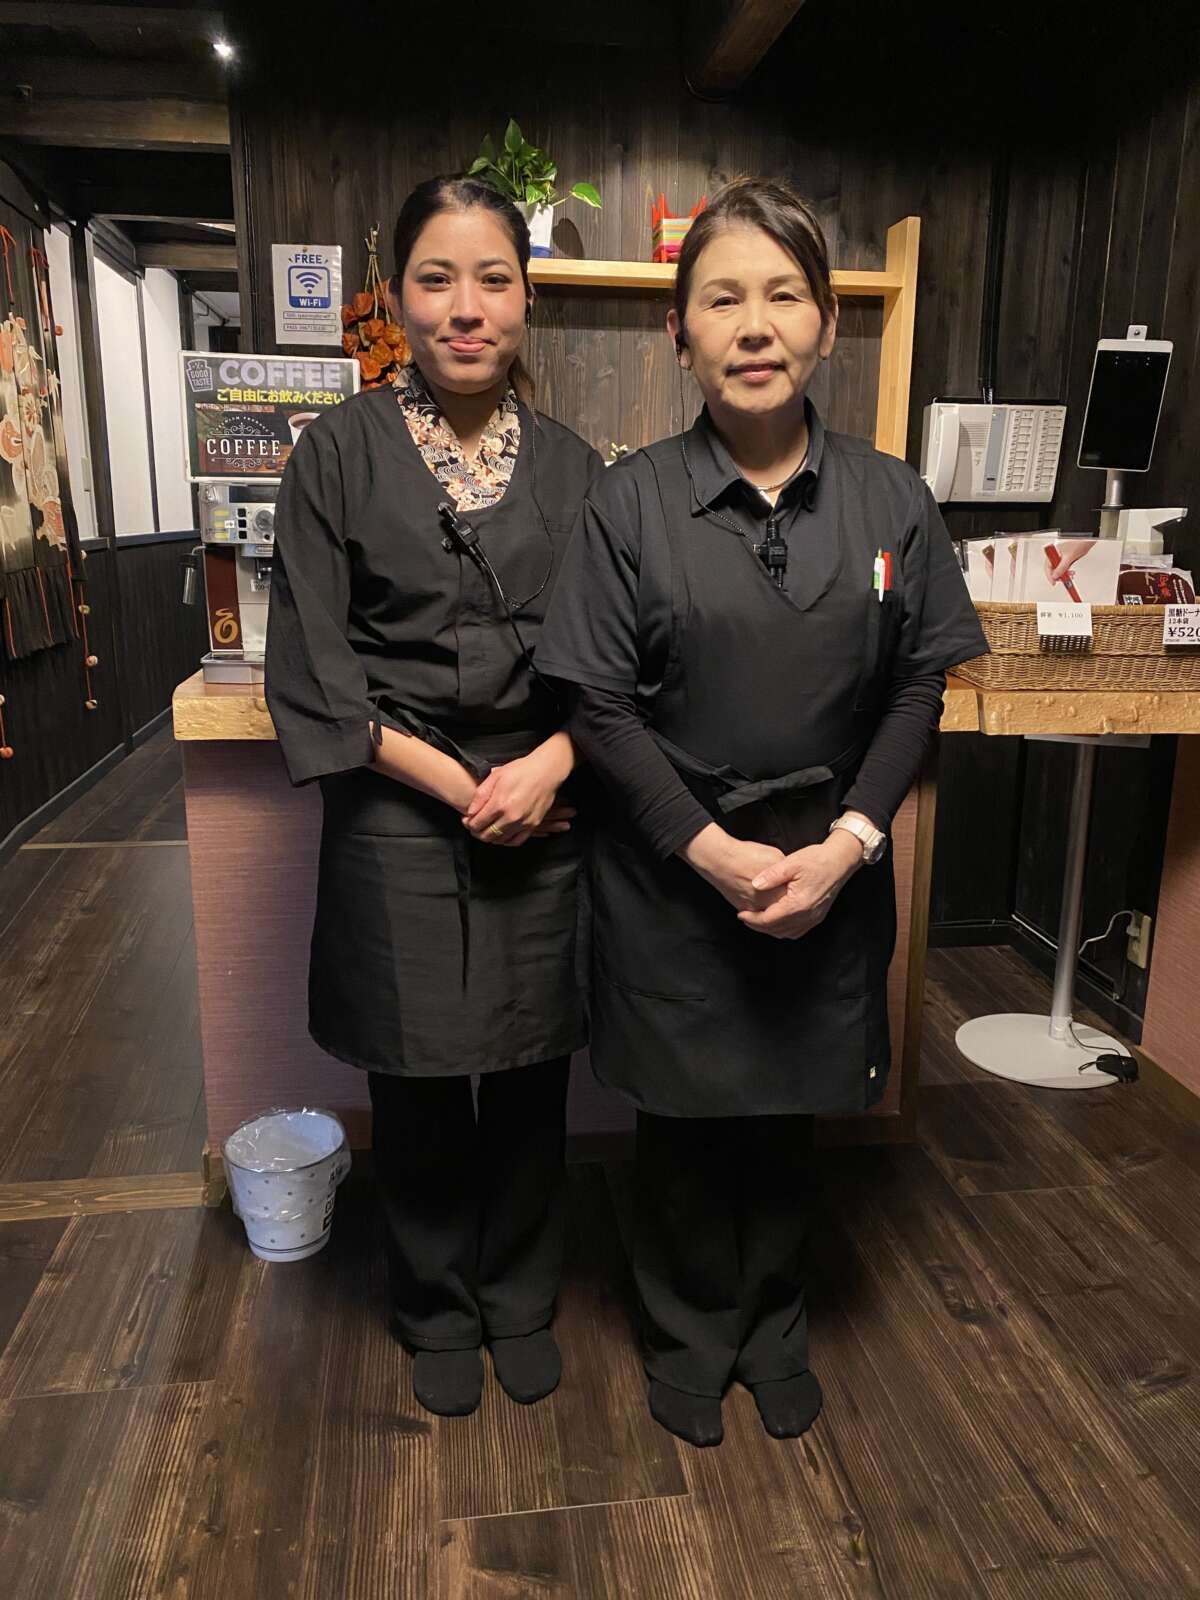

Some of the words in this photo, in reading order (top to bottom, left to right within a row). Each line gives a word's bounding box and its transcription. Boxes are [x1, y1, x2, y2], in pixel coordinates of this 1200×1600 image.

[294, 253, 323, 264] FREE
[299, 297, 321, 307] Wi-Fi
[191, 370, 209, 379] GOOD
[219, 359, 342, 389] COFFEE
[192, 378, 210, 387] TASTE
[216, 387, 345, 405] ご自由にお飲みください
[206, 438, 281, 456] COFFEE
